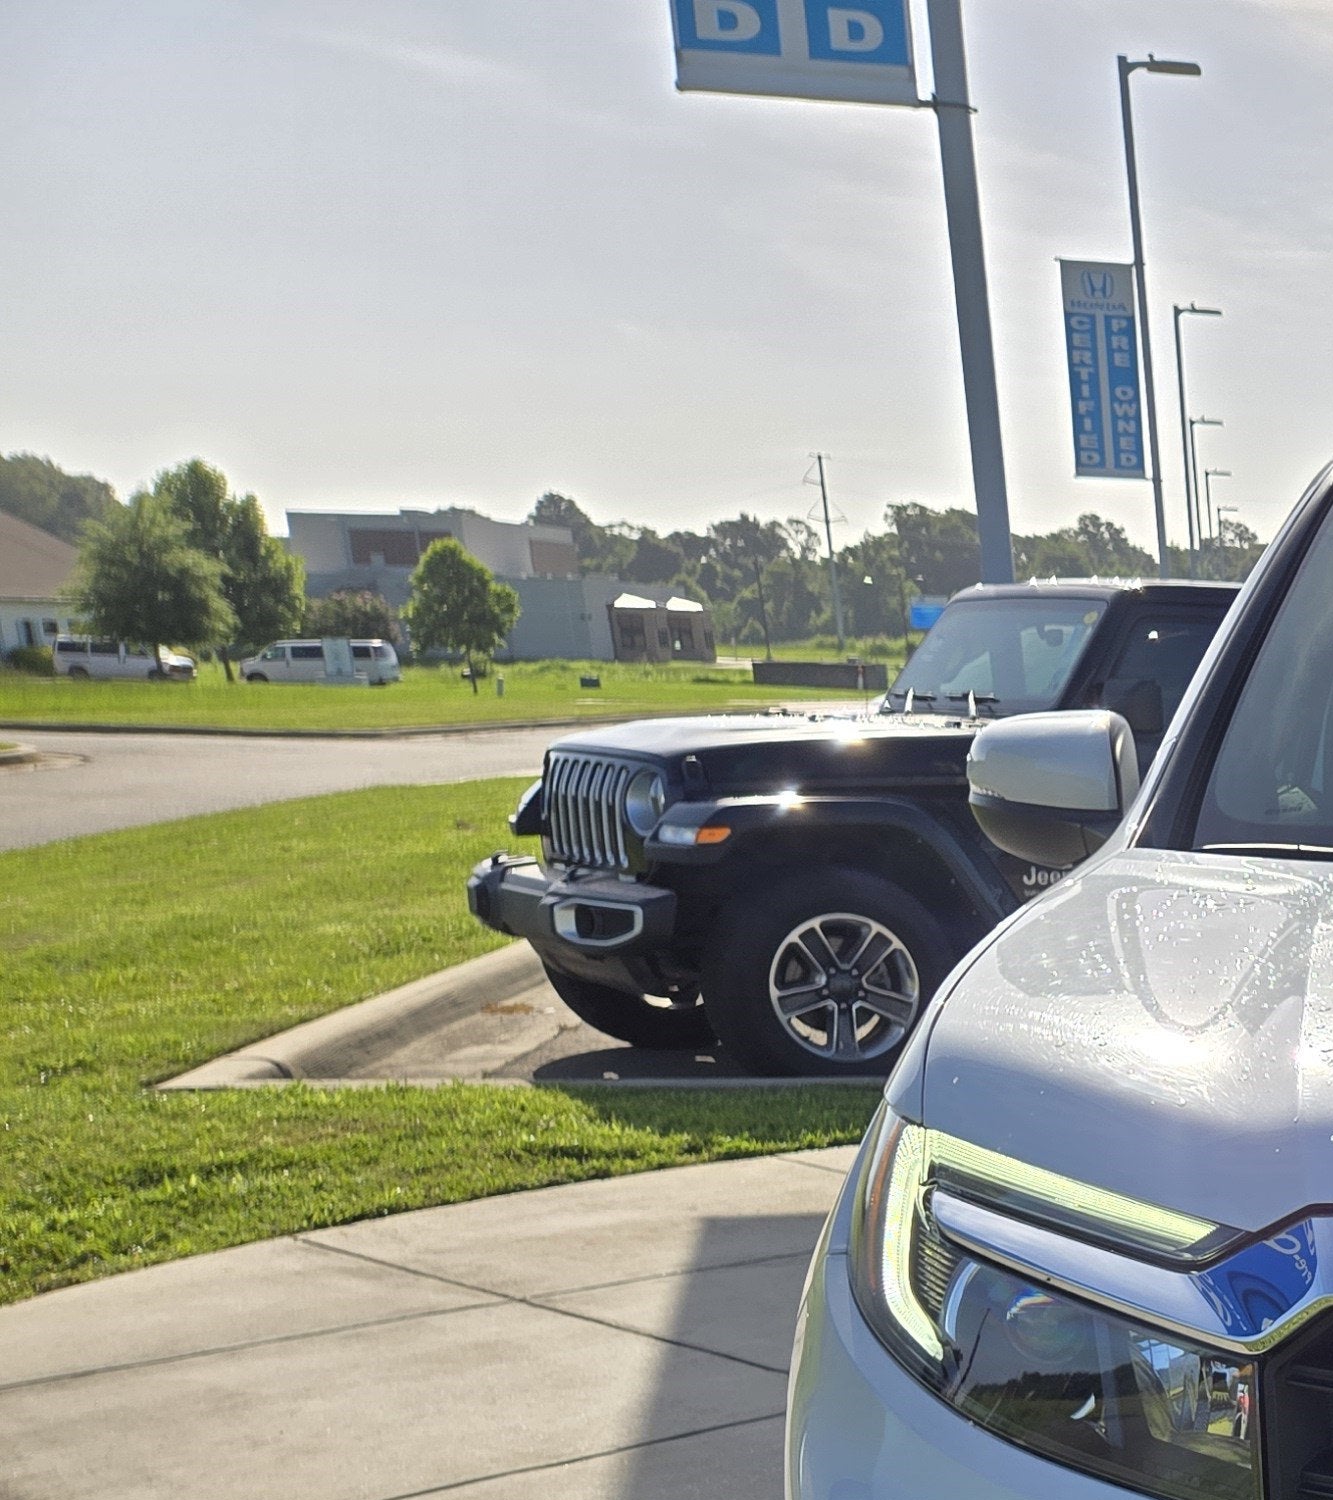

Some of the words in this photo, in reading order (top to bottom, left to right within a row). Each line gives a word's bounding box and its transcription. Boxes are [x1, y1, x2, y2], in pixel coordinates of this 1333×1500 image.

[1110, 318, 1130, 368] PRE
[1069, 315, 1100, 466] CERTIFIED
[1113, 385, 1138, 467] OWNED
